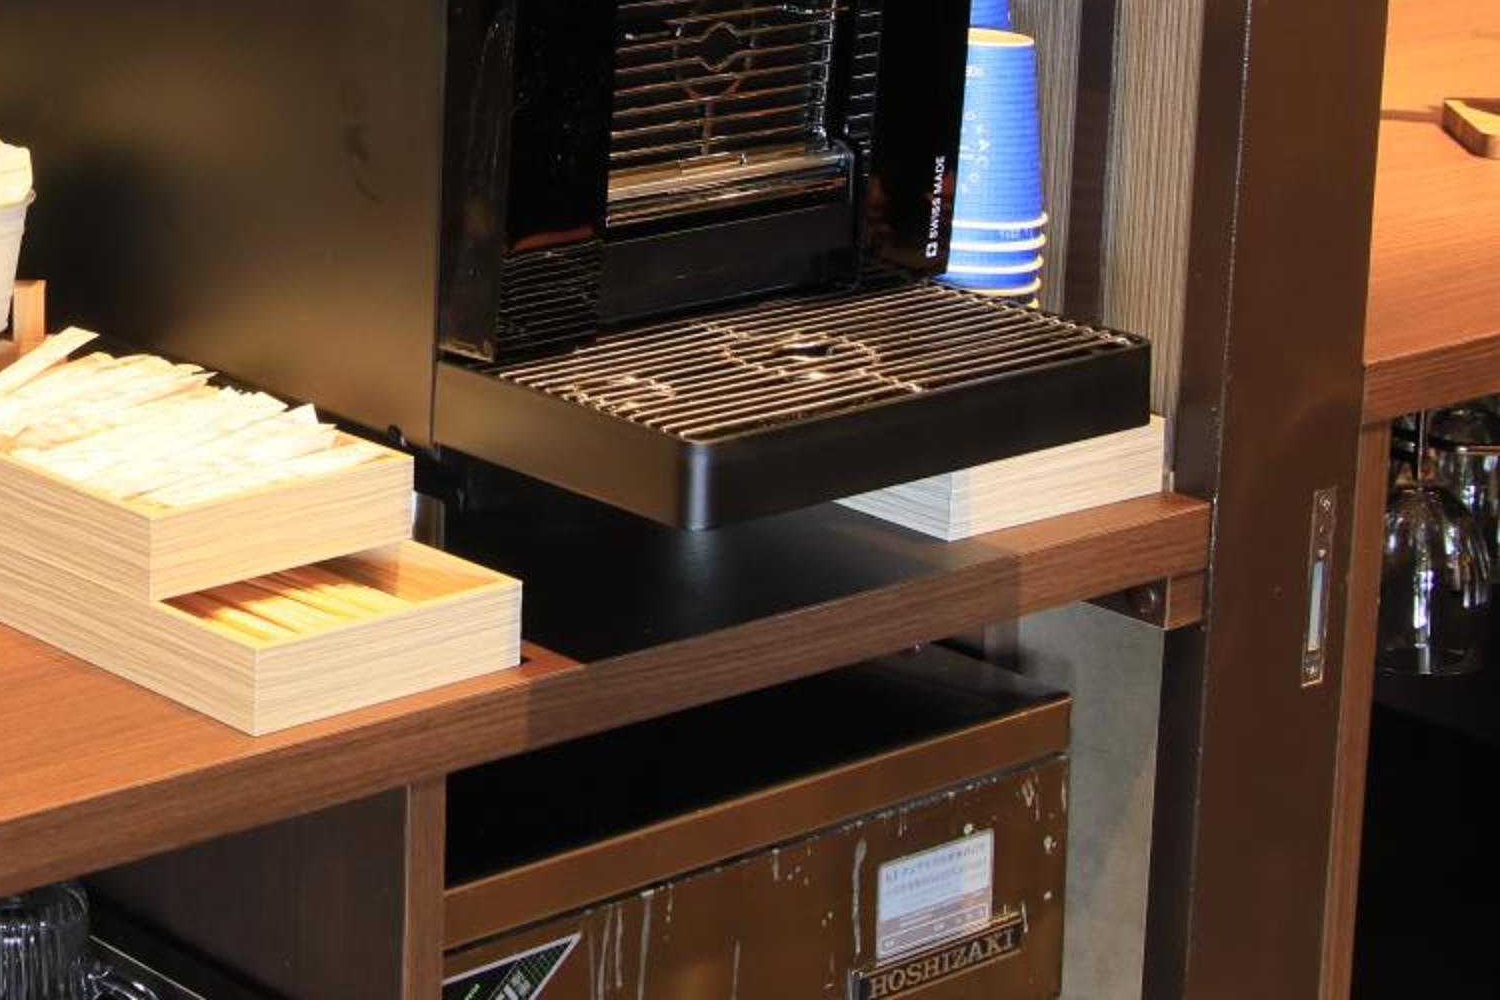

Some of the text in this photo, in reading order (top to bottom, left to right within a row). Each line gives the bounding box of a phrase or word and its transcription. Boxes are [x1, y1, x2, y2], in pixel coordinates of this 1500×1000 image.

[929, 155, 946, 239] SWISS MADE
[868, 928, 1016, 999] HOSHIZAKI
